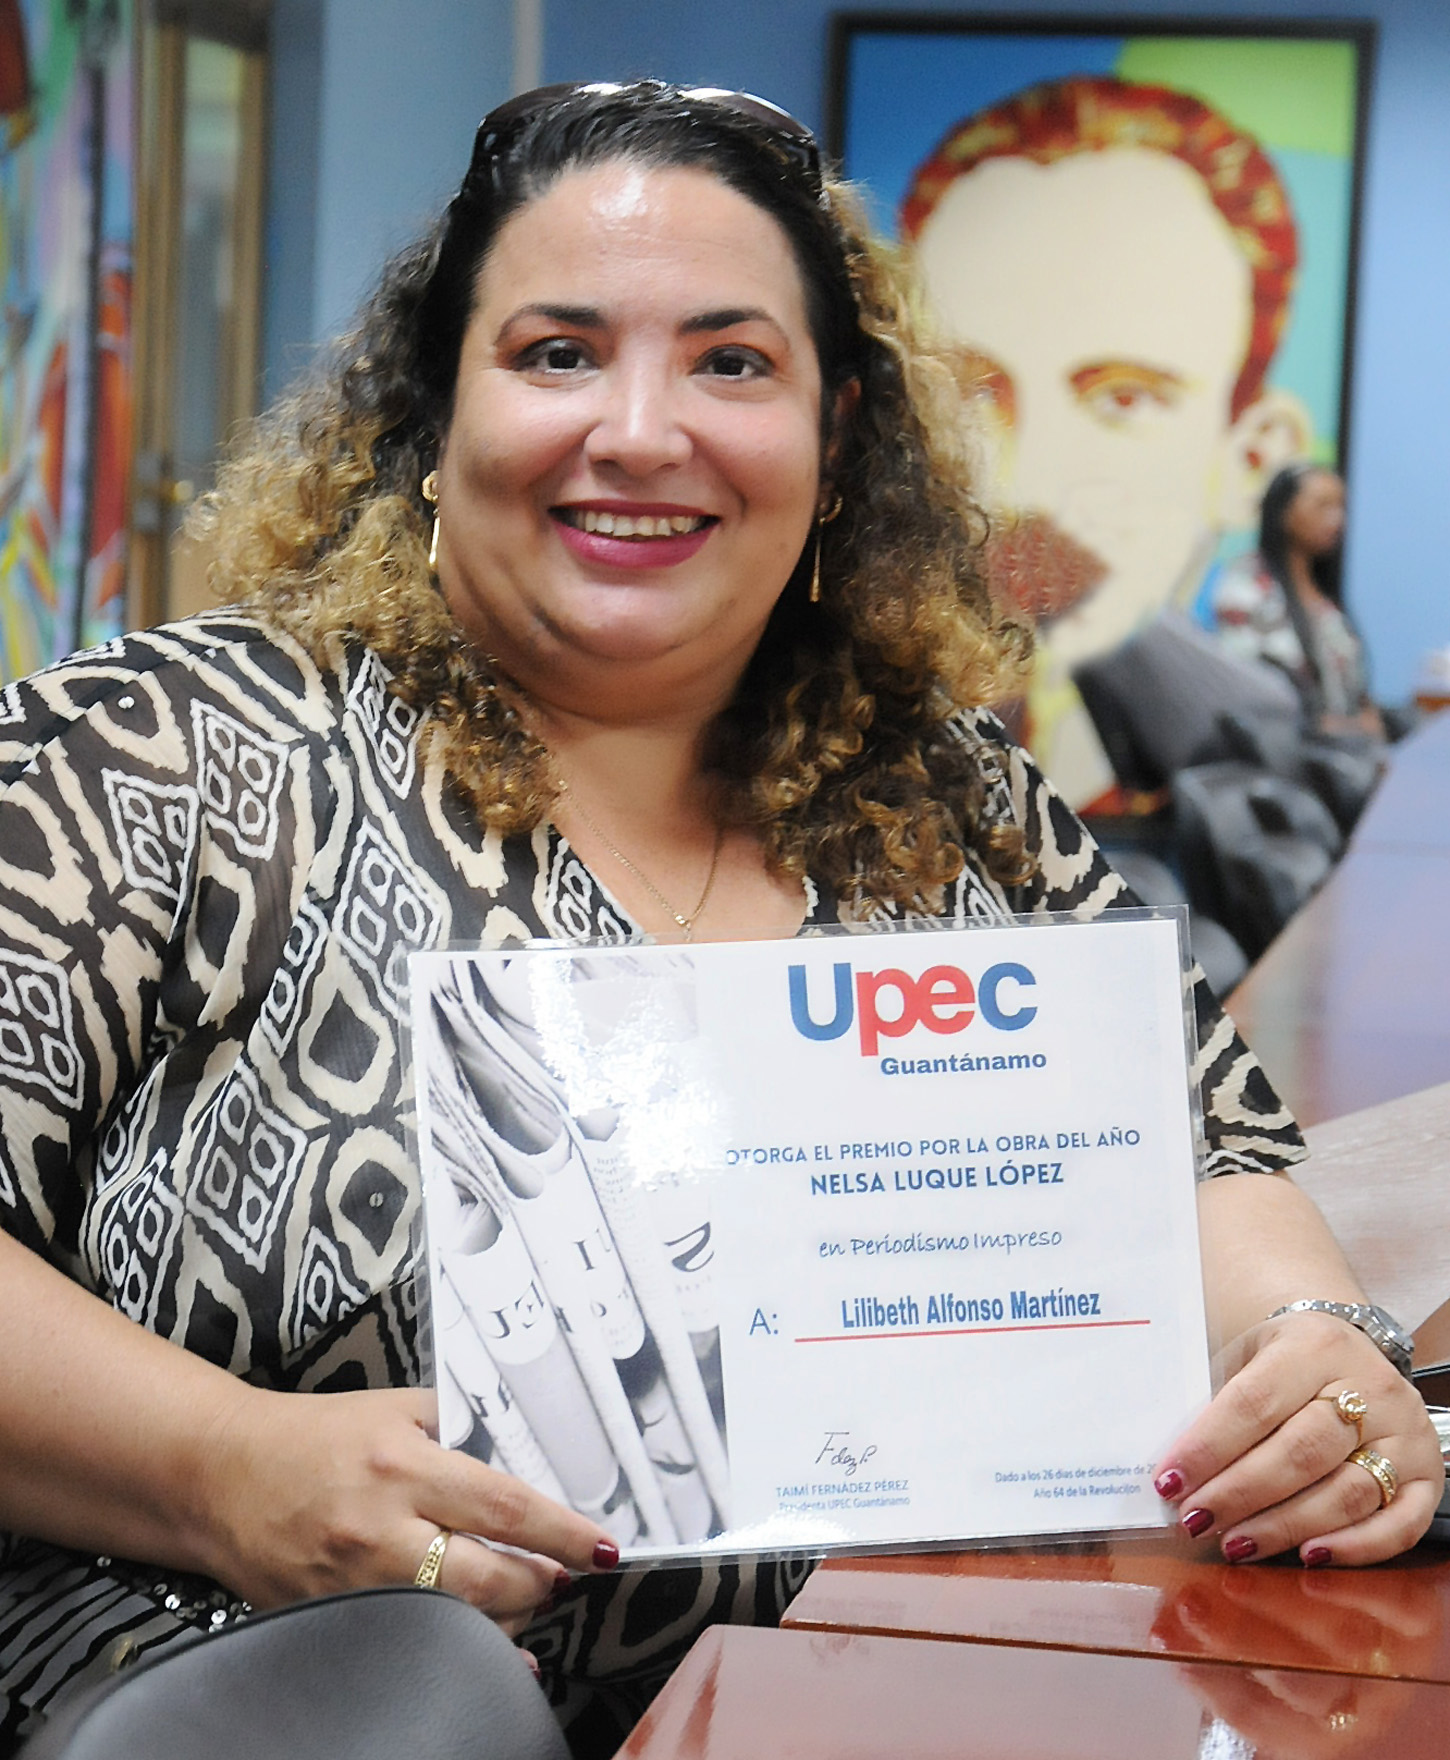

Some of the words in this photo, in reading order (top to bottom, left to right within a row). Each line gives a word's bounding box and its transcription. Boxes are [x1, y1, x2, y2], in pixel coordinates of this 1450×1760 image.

[788, 962, 1038, 1056] Upec
[880, 1053, 1047, 1075] Guantánamo
[726, 1147, 807, 1165] OTORGA
[814, 1145, 833, 1161] EL
[840, 1141, 912, 1159] PREMIO
[920, 1139, 960, 1156] POR
[967, 1137, 989, 1153] LA
[996, 1134, 1050, 1152] OBRA
[1056, 1132, 1091, 1149] DEL
[1096, 1126, 1141, 1147] AÑO
[811, 1172, 885, 1196] NELSA
[894, 1167, 977, 1192] LUQUE
[986, 1159, 1064, 1187] LÓPEZ
[819, 1241, 845, 1258] en
[974, 1230, 1063, 1256] Impreso
[749, 1308, 779, 1336] A:
[841, 1294, 920, 1329] Lilibeth
[926, 1292, 1004, 1325] Alfonso
[1010, 1287, 1102, 1320] Martínez
[874, 1478, 909, 1492] PÉREZ
[995, 1471, 1020, 1483] Dado
[1042, 1469, 1054, 1480] 26
[1075, 1468, 1087, 1478] de
[1088, 1464, 1131, 1477] diciembre
[1133, 1463, 1145, 1474] de
[827, 1498, 852, 1509] UPEC
[1053, 1486, 1064, 1497] 64
[1066, 1486, 1078, 1497] de
[1079, 1485, 1088, 1496] la
